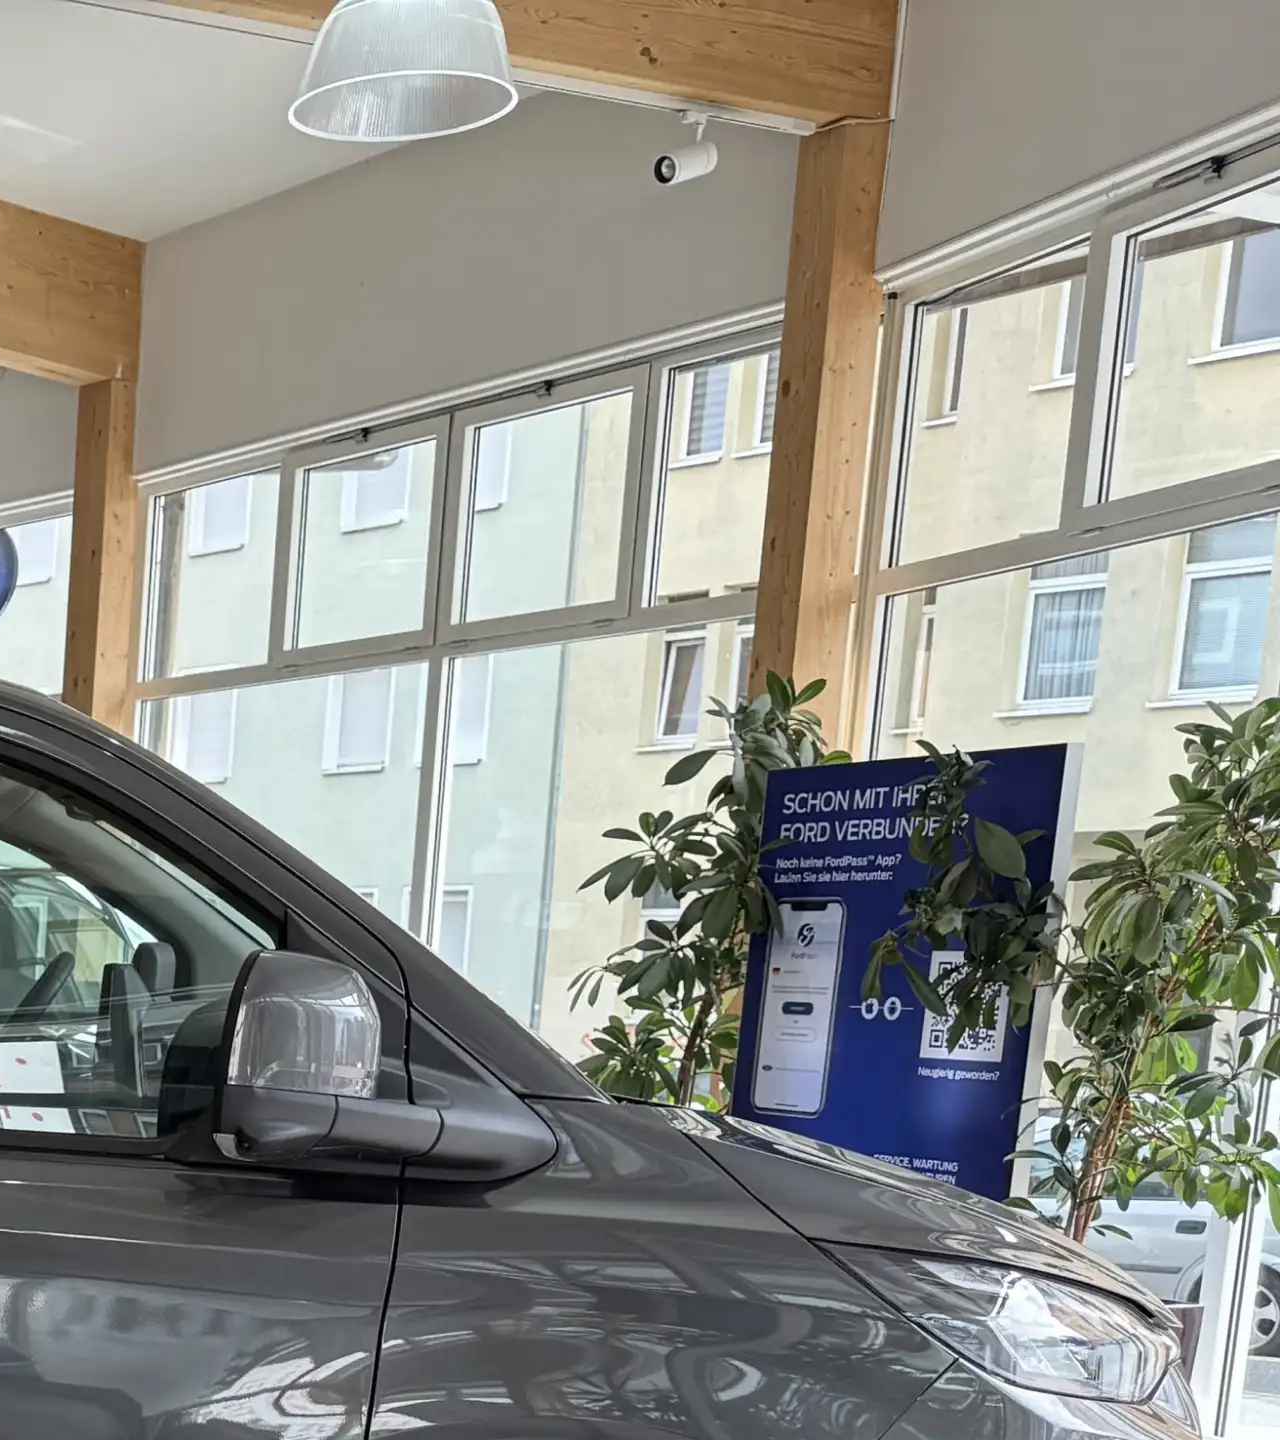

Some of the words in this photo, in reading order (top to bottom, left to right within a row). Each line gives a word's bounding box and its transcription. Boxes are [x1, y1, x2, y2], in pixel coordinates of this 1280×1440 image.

[782, 788, 849, 814] SCHON
[853, 787, 889, 810] MIT
[780, 821, 831, 843] FORD
[776, 857, 799, 869] Noch
[800, 856, 824, 868] keine
[875, 853, 902, 867] App?
[803, 872, 817, 882] Sie
[818, 871, 831, 882] sie
[832, 870, 849, 881] hier
[851, 870, 893, 881] herunter:
[912, 1158, 958, 1172] WARTUNG
